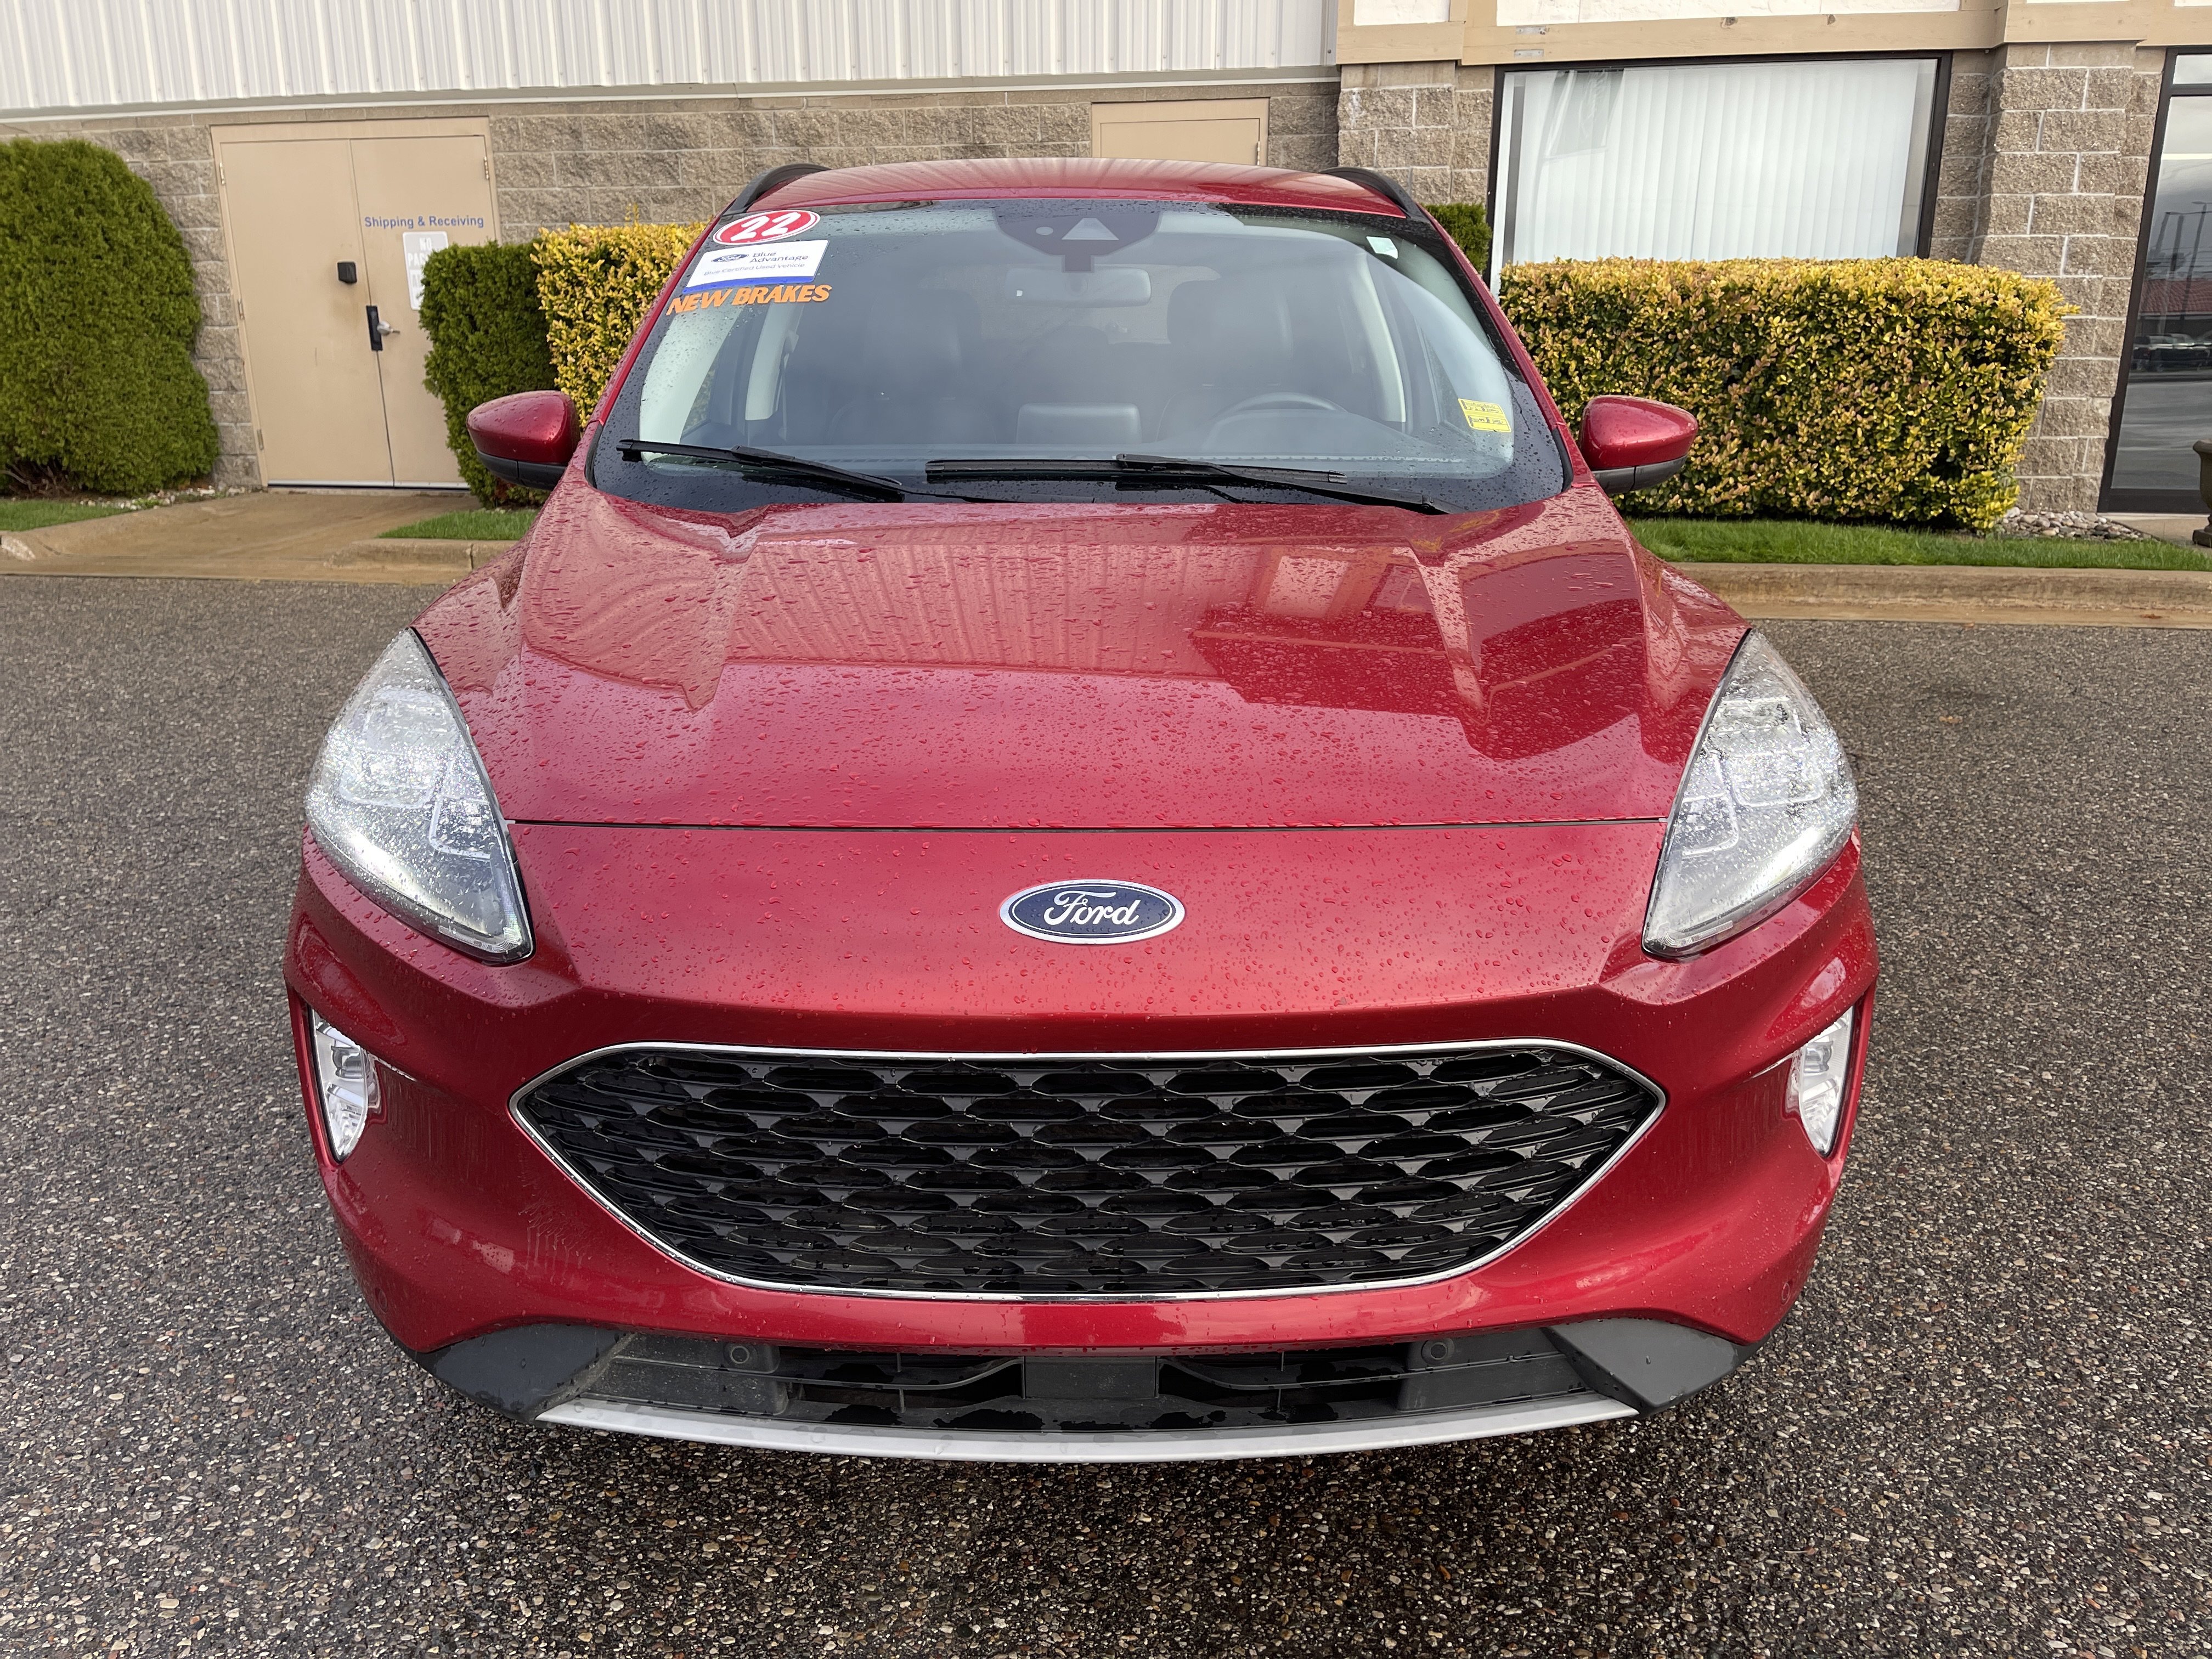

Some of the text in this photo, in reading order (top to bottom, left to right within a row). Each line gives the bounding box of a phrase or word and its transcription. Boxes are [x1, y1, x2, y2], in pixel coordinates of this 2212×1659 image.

[364, 216, 484, 229] Shipping & Receiving
[730, 212, 802, 242] 22
[419, 237, 432, 251] NO
[749, 255, 809, 263] Advantage
[666, 284, 833, 315] NEW BRAKES
[1043, 890, 1142, 926] Ford
